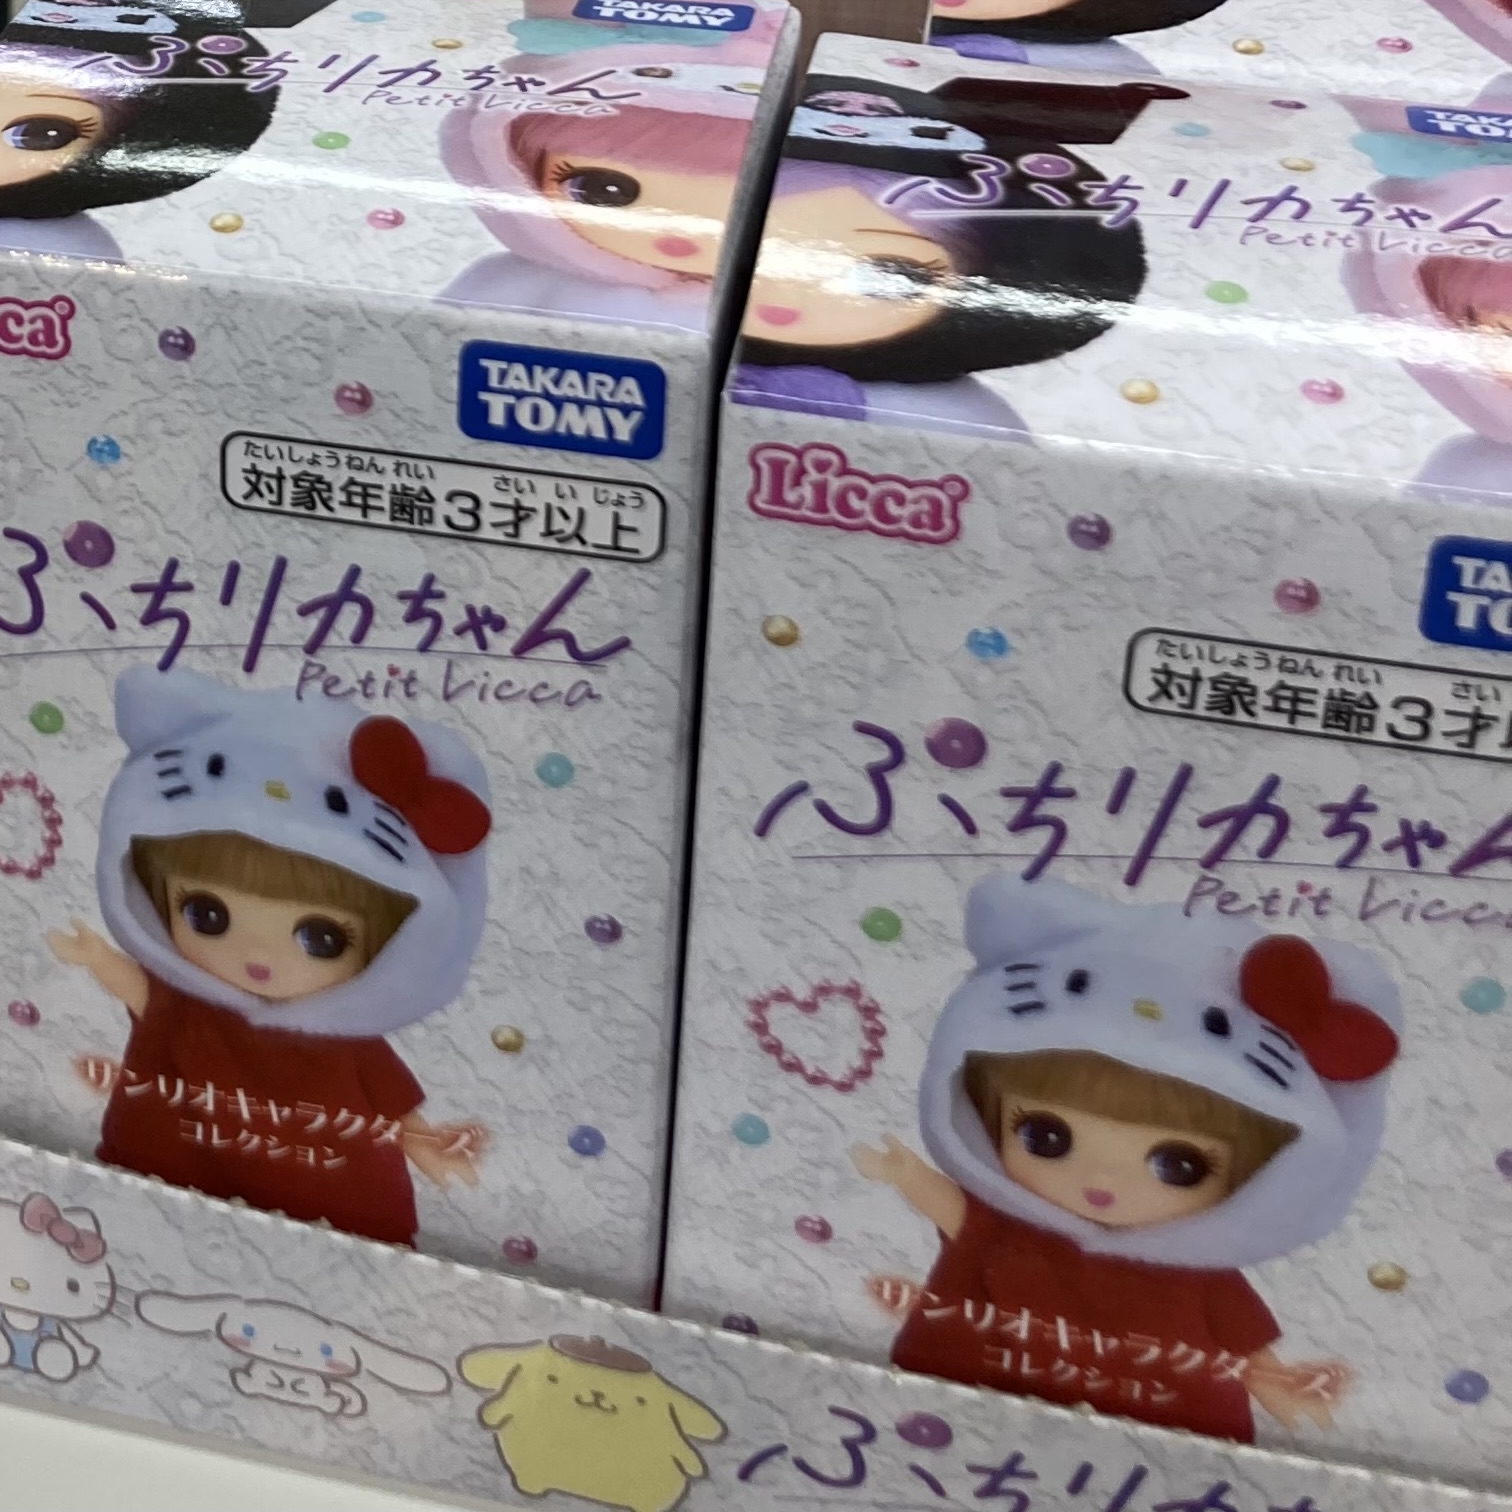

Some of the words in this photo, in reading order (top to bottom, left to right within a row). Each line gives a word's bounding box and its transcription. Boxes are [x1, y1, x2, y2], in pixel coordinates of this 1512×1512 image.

[595, 6, 735, 29] TOMY
[71, 34, 642, 101] ぷちリカちゃん
[361, 86, 458, 109] Petit
[483, 92, 621, 117] Licca
[1238, 223, 1360, 250] Petit
[477, 357, 646, 406] TAKARA
[478, 391, 644, 443] TOMY
[241, 462, 641, 555] 対象年齢3才以上
[748, 443, 971, 546] Licca
[296, 660, 419, 701] Petit
[444, 659, 602, 704] Licca
[1146, 662, 1512, 751] 対象年齢3才
[1183, 875, 1333, 918] Petit
[1359, 876, 1512, 929] Licc
[78, 1057, 487, 1160] サンリオキャラクターズ
[180, 1118, 348, 1170] コレクション
[984, 1344, 1177, 1404] コレクション
[738, 1406, 1321, 1512] ぷちリ
